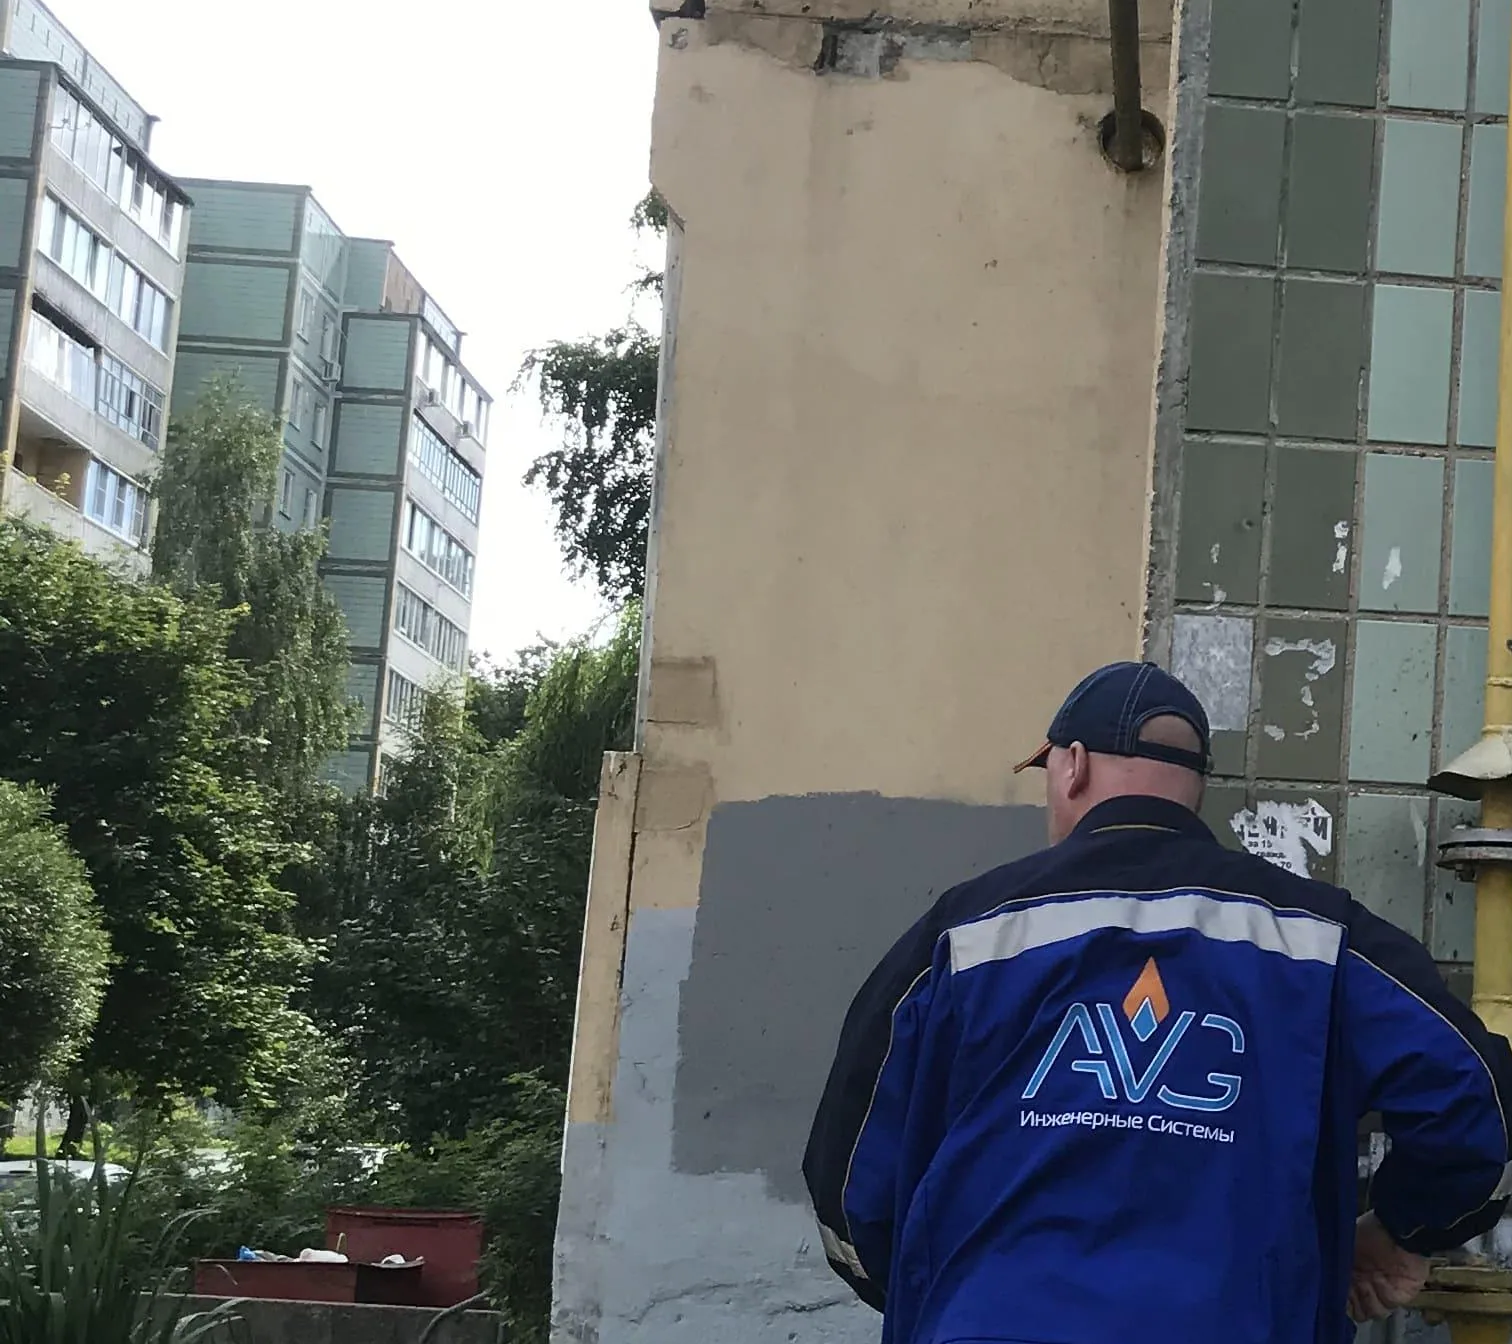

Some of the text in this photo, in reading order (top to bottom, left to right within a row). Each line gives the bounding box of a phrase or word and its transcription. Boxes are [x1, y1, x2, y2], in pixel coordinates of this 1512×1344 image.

[1021, 1002, 1244, 1112] AVG
[1020, 1110, 1235, 1142] Инженерные Системы
